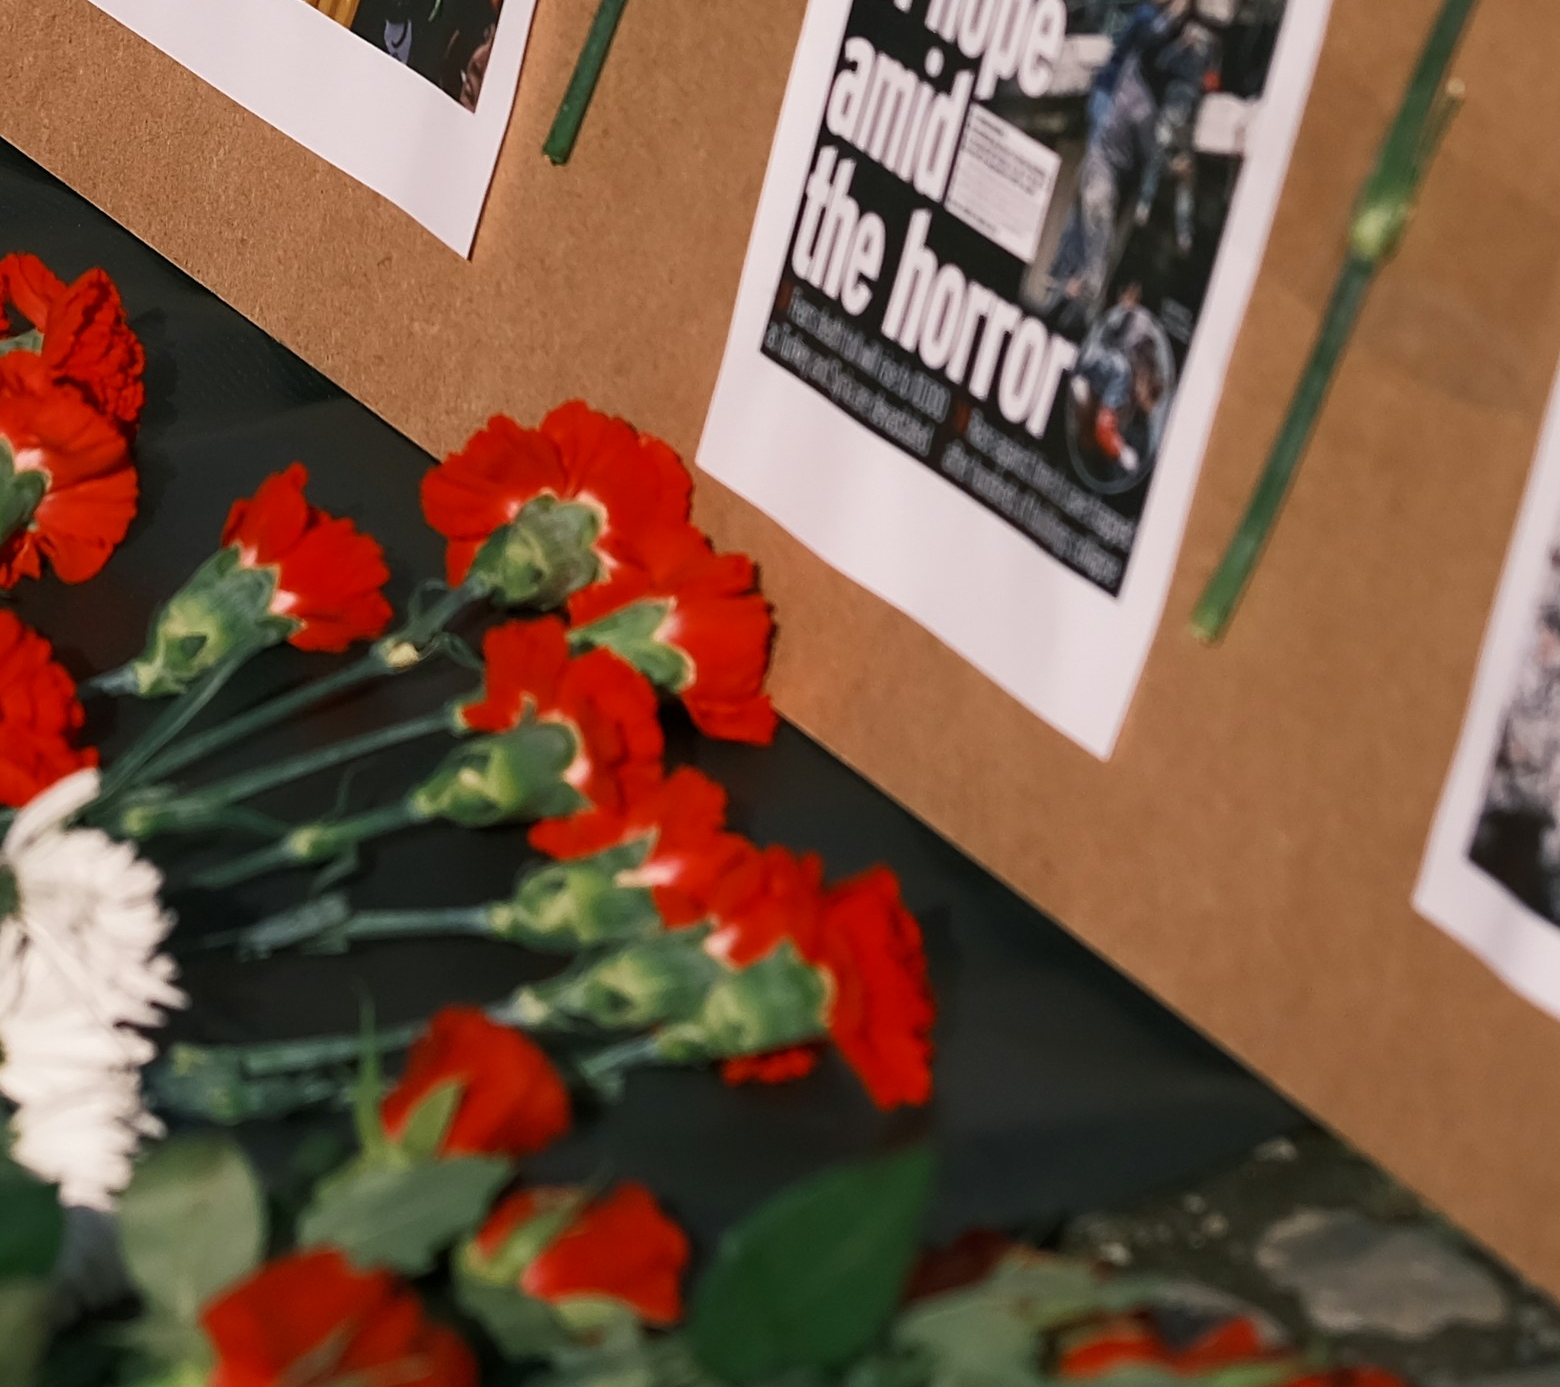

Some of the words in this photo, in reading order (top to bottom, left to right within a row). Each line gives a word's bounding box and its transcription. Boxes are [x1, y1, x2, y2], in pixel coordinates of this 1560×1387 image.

[825, 36, 975, 205] amid
[791, 145, 886, 317] the
[880, 207, 1081, 440] horror
